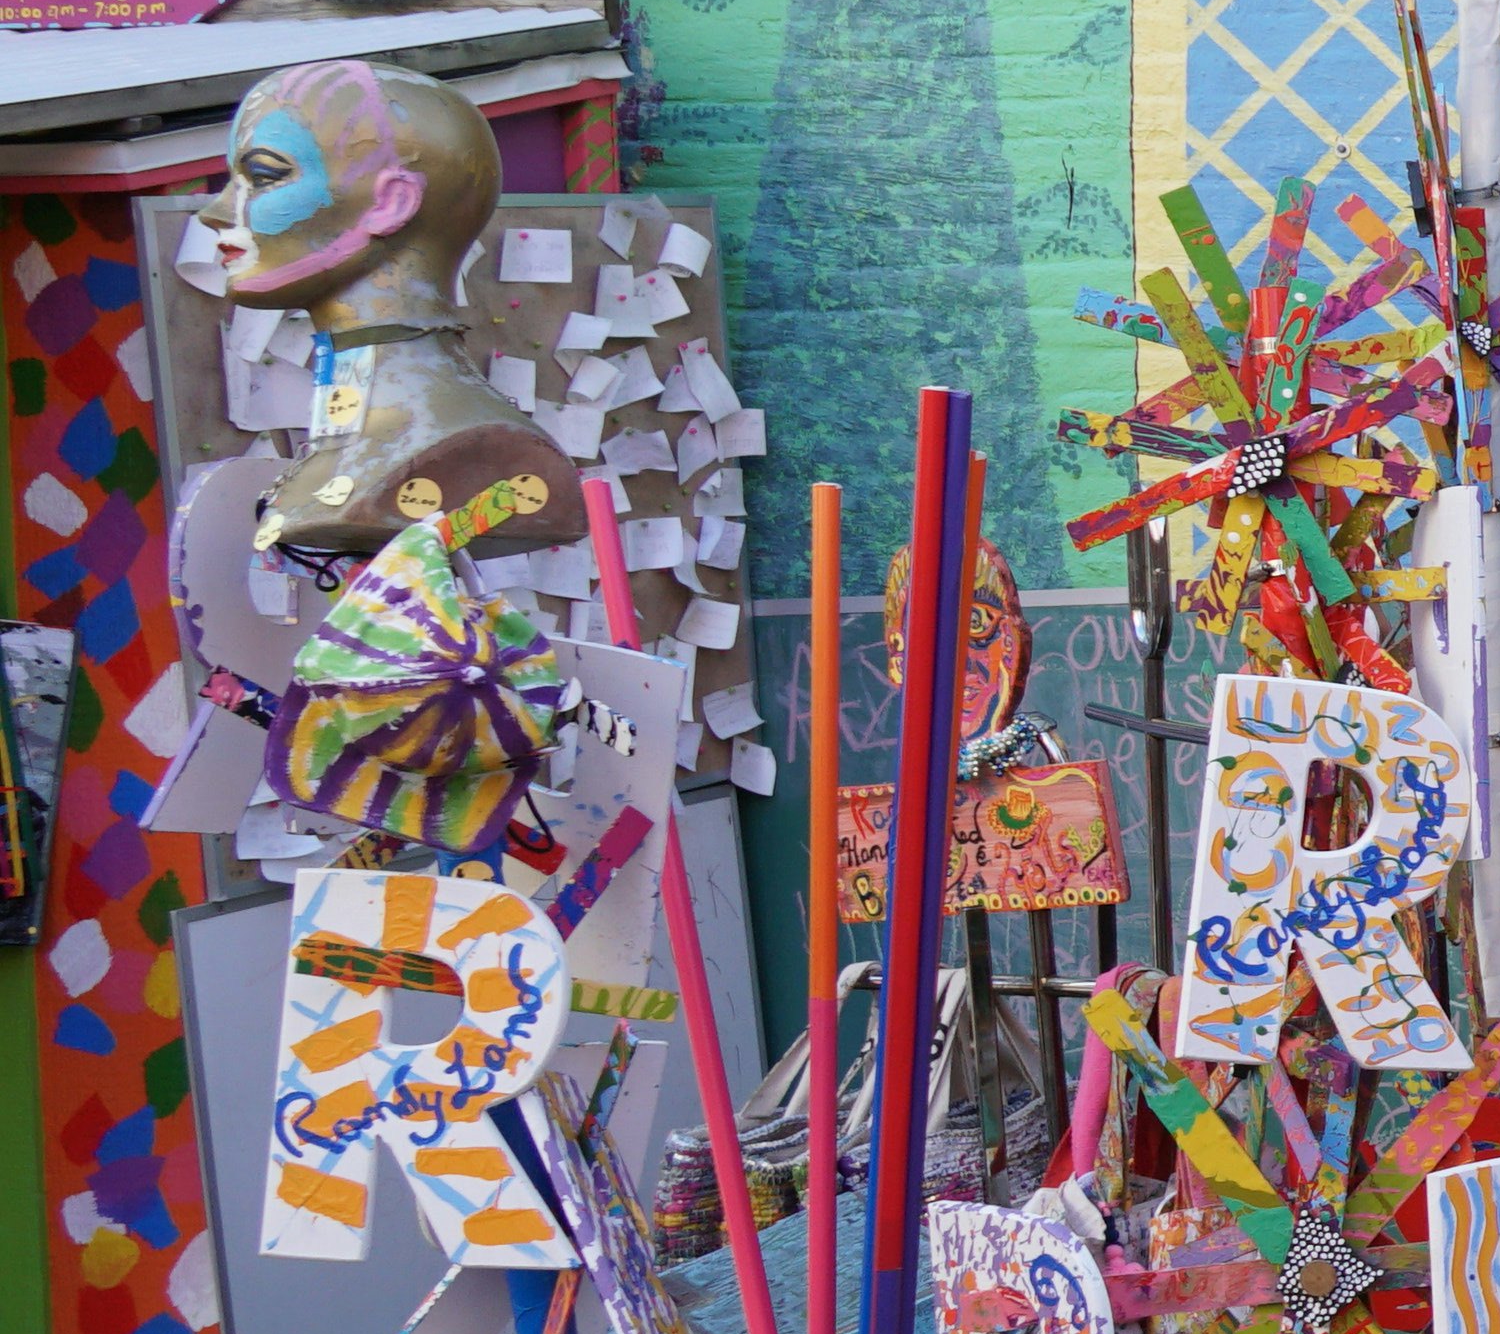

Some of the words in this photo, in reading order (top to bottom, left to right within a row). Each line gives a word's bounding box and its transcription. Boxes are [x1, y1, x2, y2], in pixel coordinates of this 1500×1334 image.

[1196, 877, 1367, 982] Randy
[274, 1063, 445, 1158] Randy
[446, 942, 544, 1110] Land
